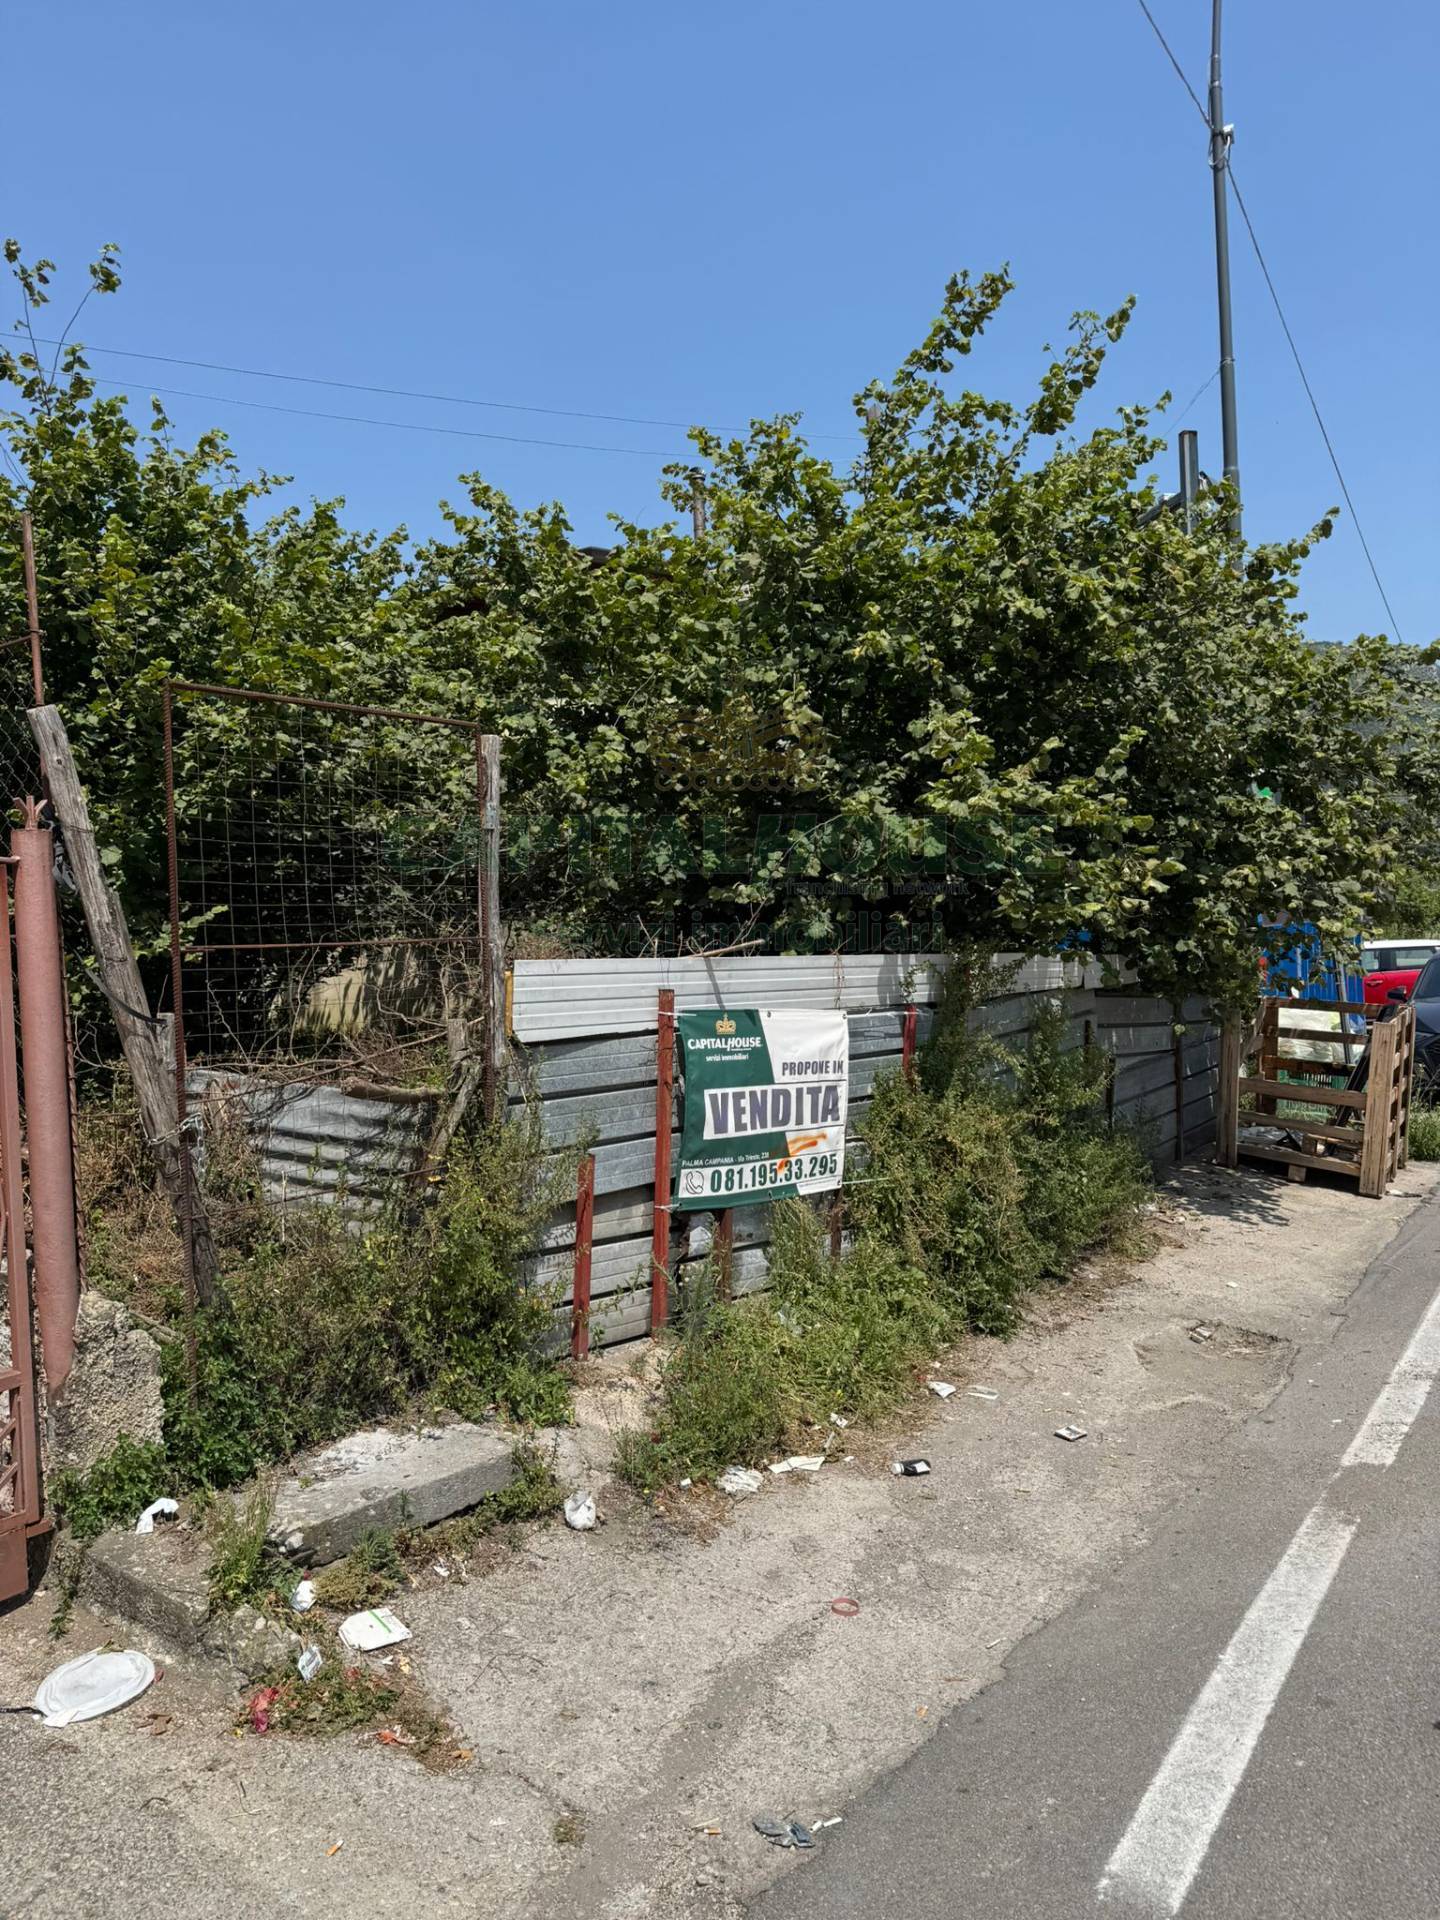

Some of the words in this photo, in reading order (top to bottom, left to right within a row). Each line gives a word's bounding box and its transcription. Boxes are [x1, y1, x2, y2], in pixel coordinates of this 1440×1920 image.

[688, 1037, 762, 1051] CAPITALHOUSE
[782, 1060, 830, 1076] PROPONE
[833, 1060, 844, 1075] IN
[709, 1085, 840, 1135] VENDITA
[682, 1159, 703, 1167] PALMA
[704, 1157, 734, 1166] CAMPANIA
[710, 1153, 837, 1193] 081.195.33.295
